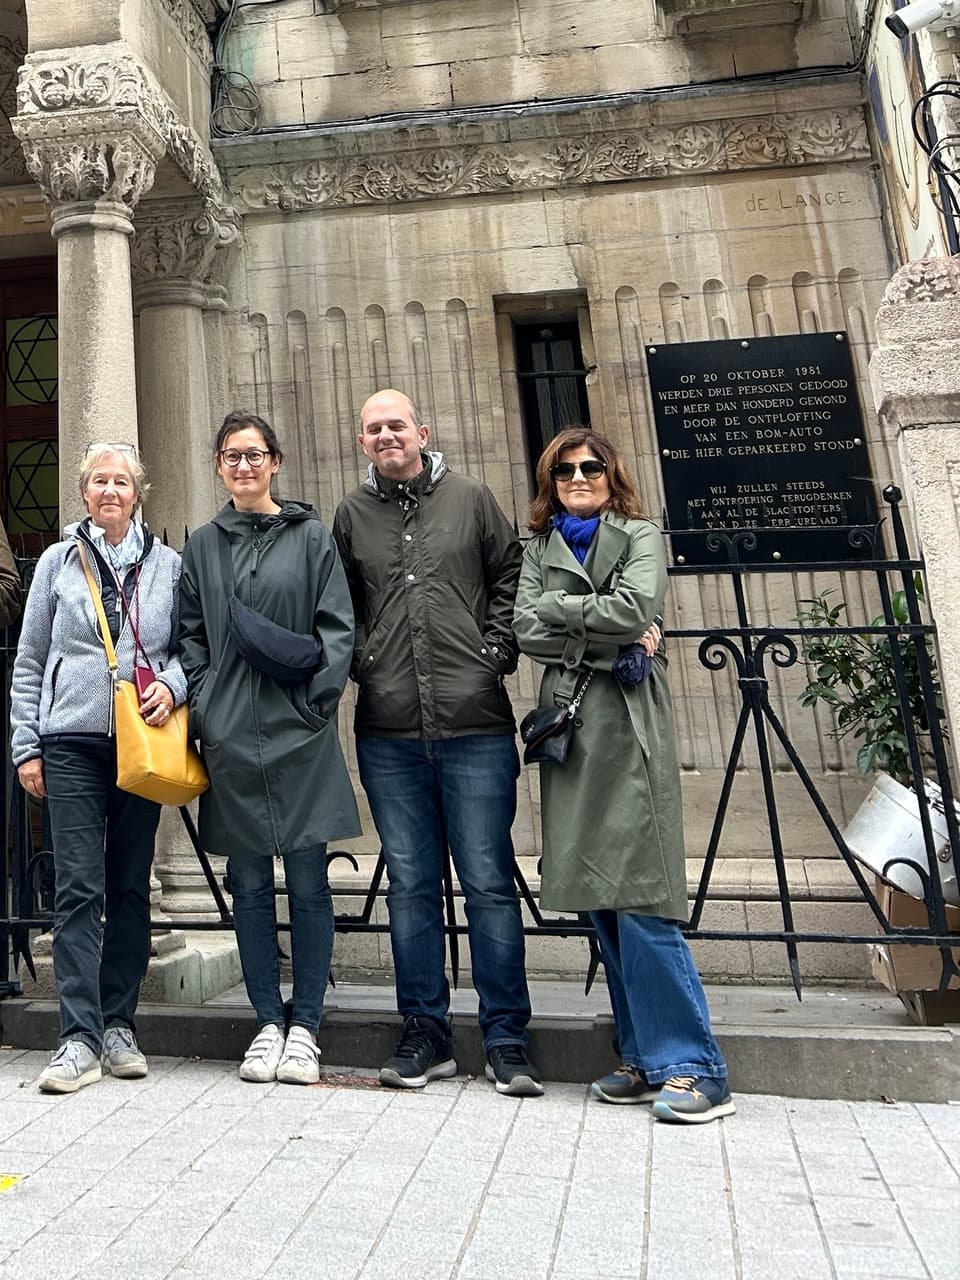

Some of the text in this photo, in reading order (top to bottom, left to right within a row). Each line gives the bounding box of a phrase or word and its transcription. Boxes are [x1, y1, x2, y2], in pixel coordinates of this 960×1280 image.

[680, 365, 822, 384] OP 20 OKTOBER 1981
[658, 379, 848, 401] WERDEN DRIE PERSONEN GEDOOD
[664, 395, 847, 415] EN MEER DAN HONDERD GEWOND
[683, 411, 832, 429] DOOR DE ONTPLOFFING
[694, 426, 823, 443] VAN EEN BOM-AUTO
[671, 440, 854, 460] DIE HIER GEPARKEERD STOND
[710, 480, 825, 495] WIJ ZULLEN STEEDS
[687, 491, 852, 508] MET ONTROERING TERUGDENKEN
[726, 509, 740, 518] AL
[745, 508, 759, 517] DE
[707, 521, 726, 529] VN
[732, 520, 759, 529] DZE
